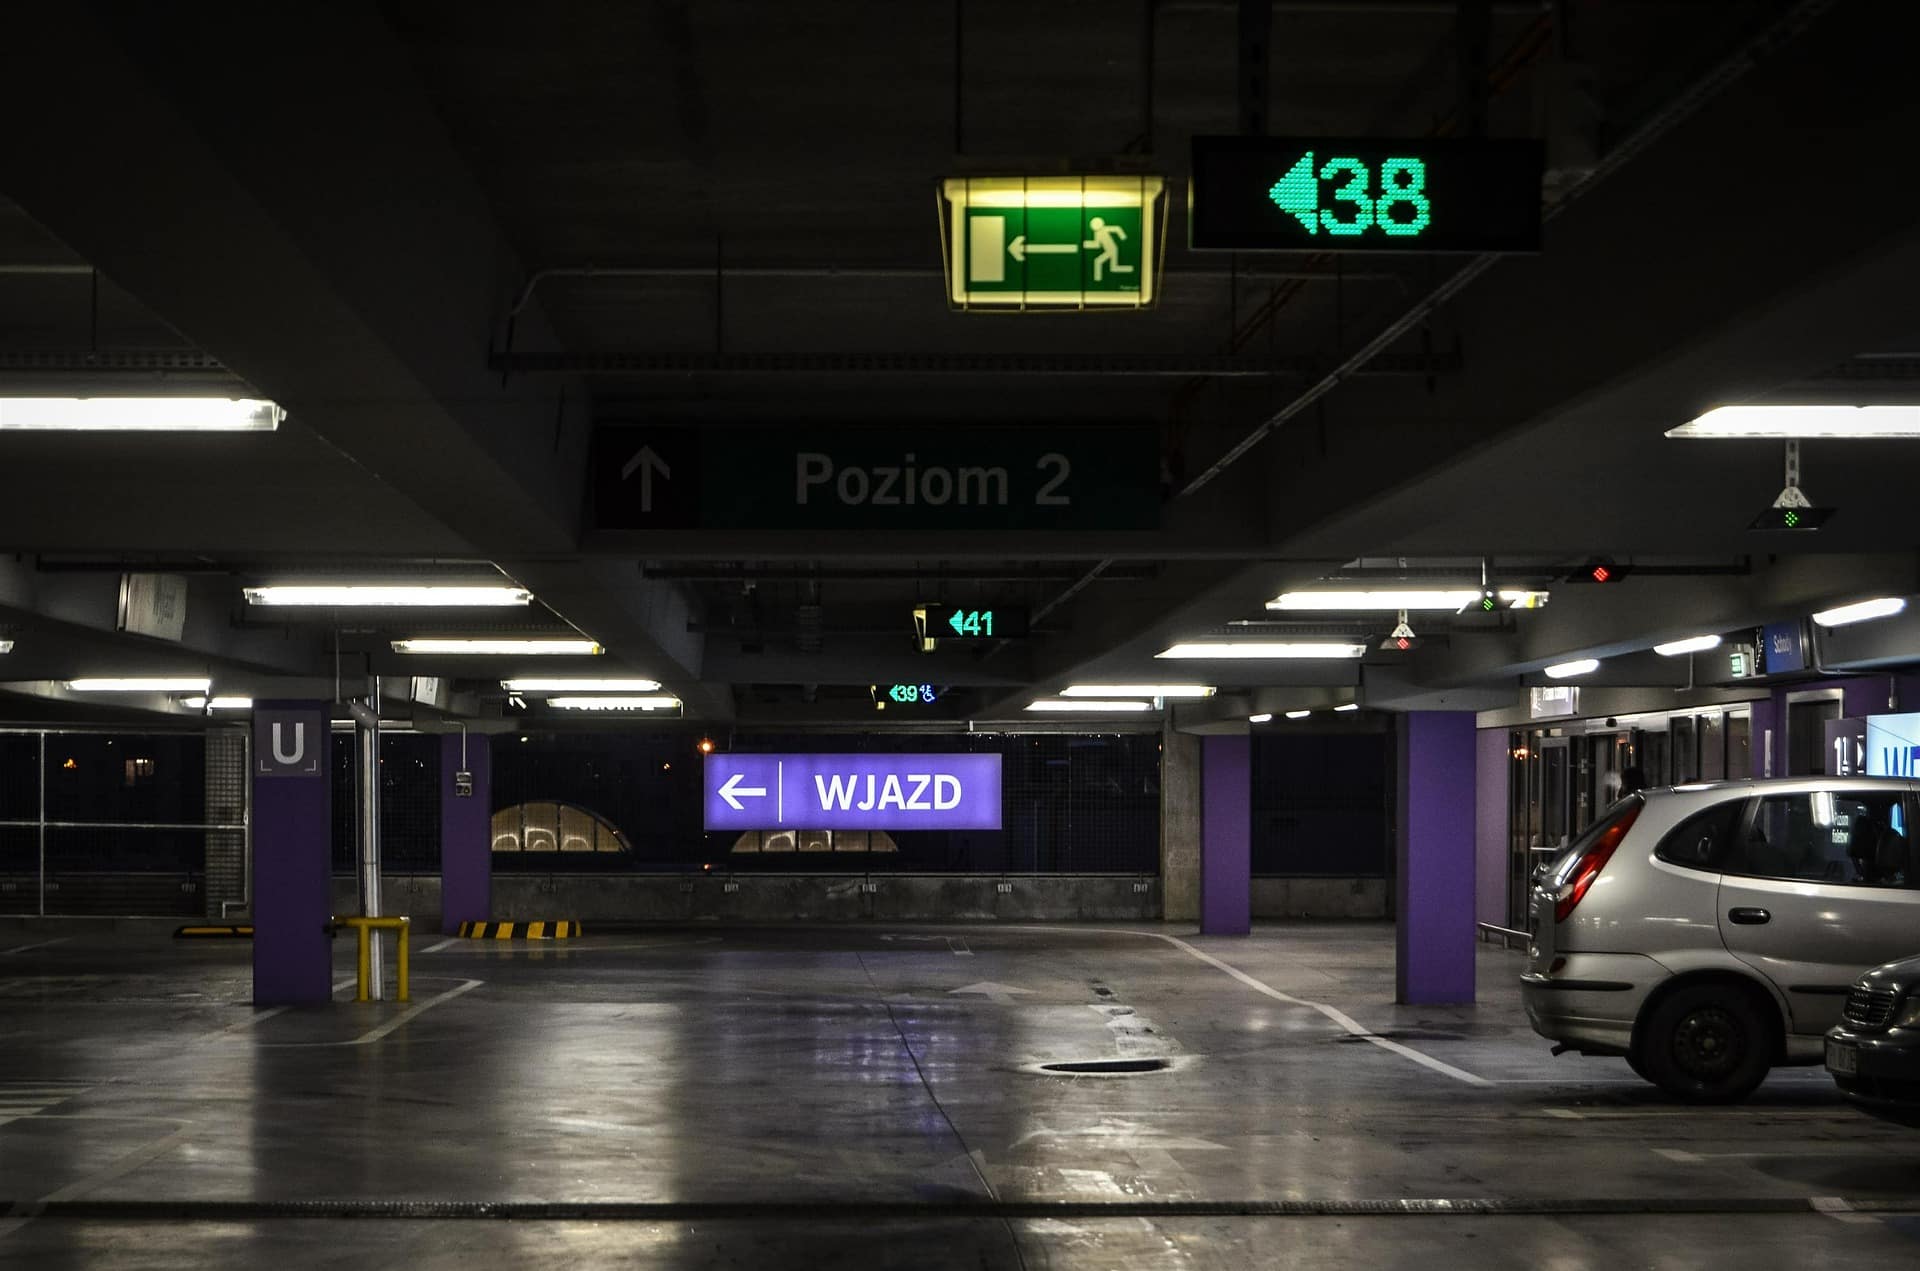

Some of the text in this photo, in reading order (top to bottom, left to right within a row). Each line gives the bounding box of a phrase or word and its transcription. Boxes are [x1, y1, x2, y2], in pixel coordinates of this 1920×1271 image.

[1320, 158, 1430, 235] 38
[796, 452, 1072, 505] Poziom 2
[963, 610, 992, 636] 41
[897, 685, 918, 702] 39
[273, 723, 304, 764] U
[815, 774, 962, 811] WJAZD
